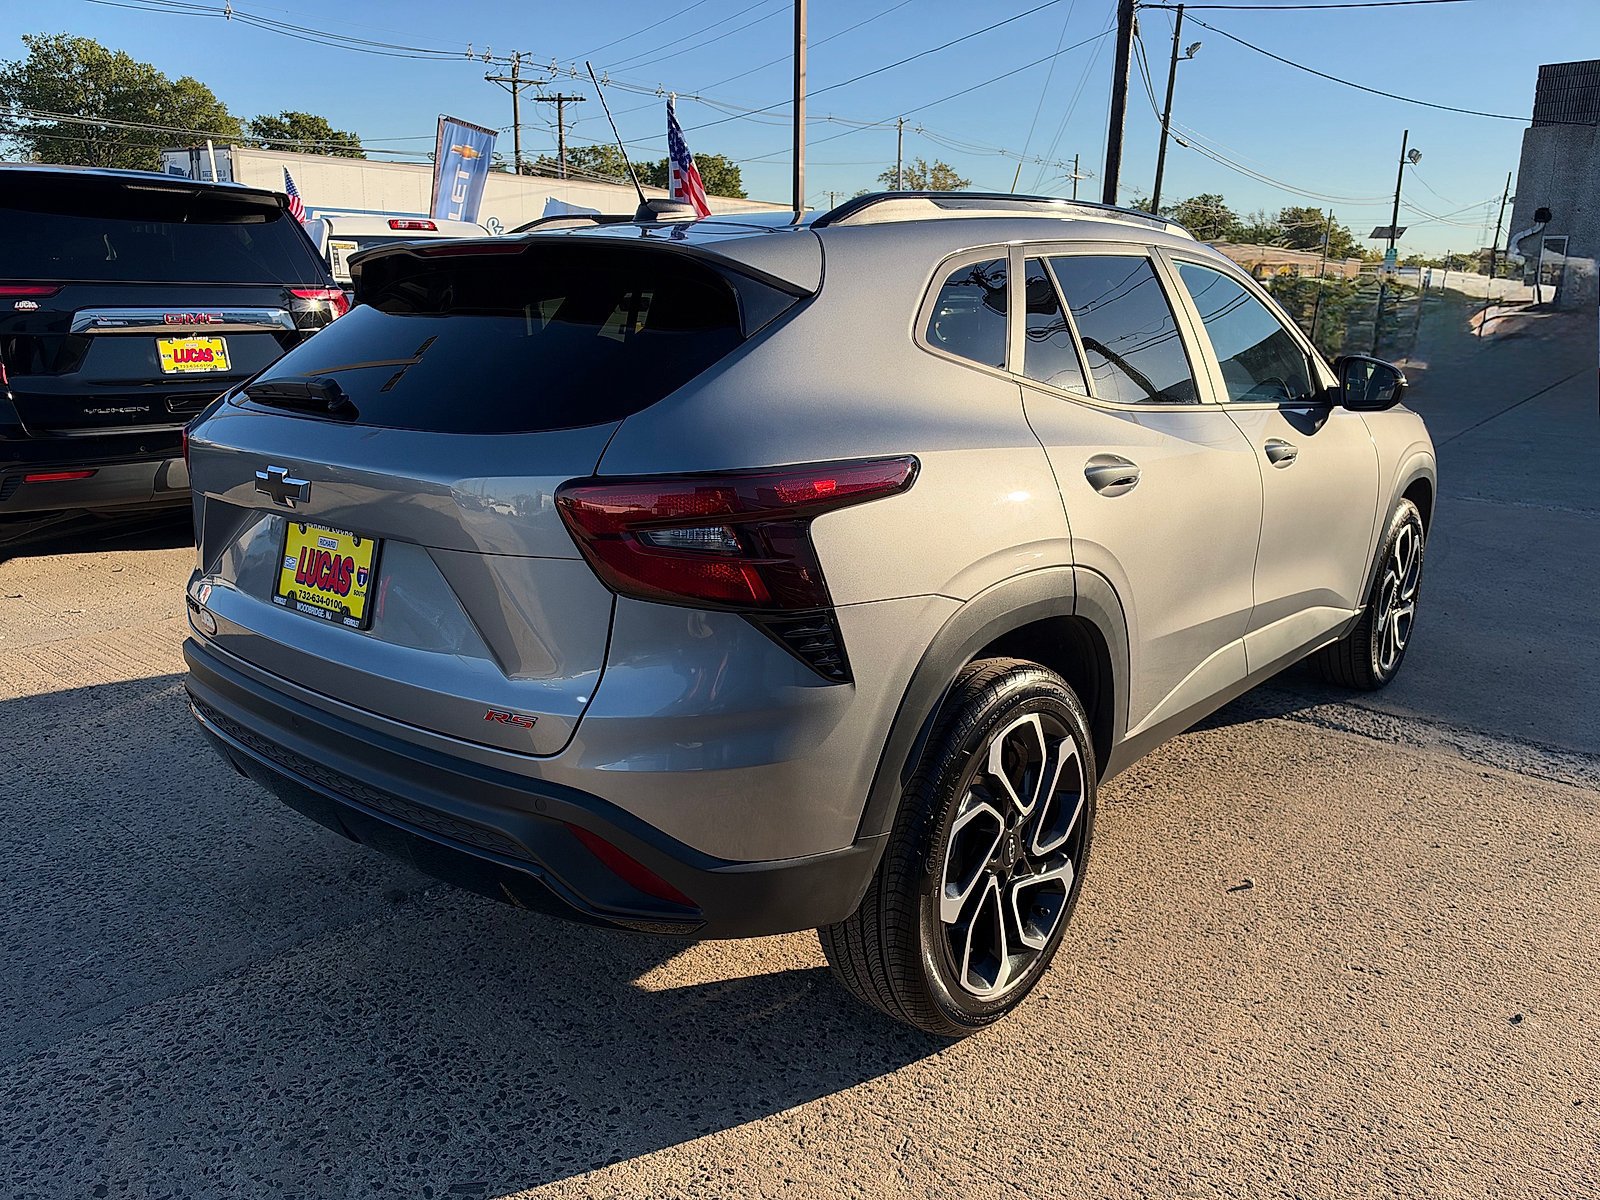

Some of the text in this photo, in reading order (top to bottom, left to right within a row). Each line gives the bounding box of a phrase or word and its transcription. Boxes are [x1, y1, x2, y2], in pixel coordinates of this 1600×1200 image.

[448, 163, 470, 220] LET
[164, 312, 224, 324] GMC
[173, 348, 214, 363] LUCAS
[319, 538, 337, 549] RICHARD
[295, 546, 354, 597] LUCAS
[298, 590, 342, 609] 732-634-0100
[325, 611, 333, 620] NJ
[483, 709, 539, 729] RS
